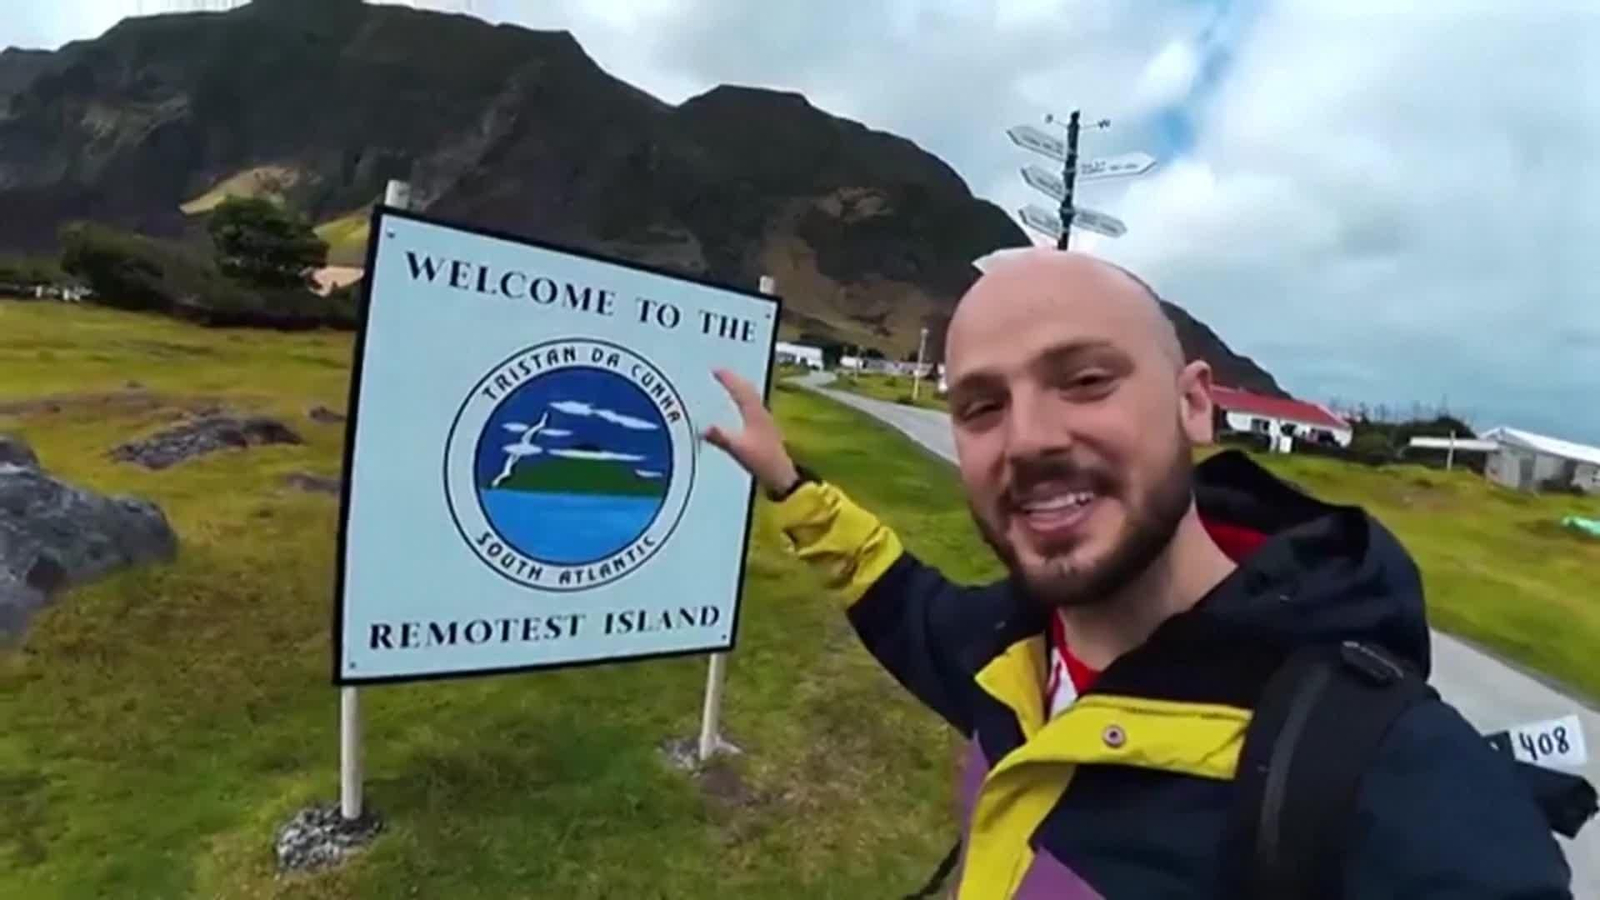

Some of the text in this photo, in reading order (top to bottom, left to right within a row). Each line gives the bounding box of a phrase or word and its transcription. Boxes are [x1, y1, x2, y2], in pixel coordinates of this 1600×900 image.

[407, 252, 757, 342] WELCOME TO THE
[482, 346, 577, 402] TRISTAN
[591, 346, 621, 368] DA
[475, 531, 657, 586] SOUTH ATLANTIC
[370, 604, 721, 650] REMOTEST ISLAND
[1519, 726, 1570, 761] 408
